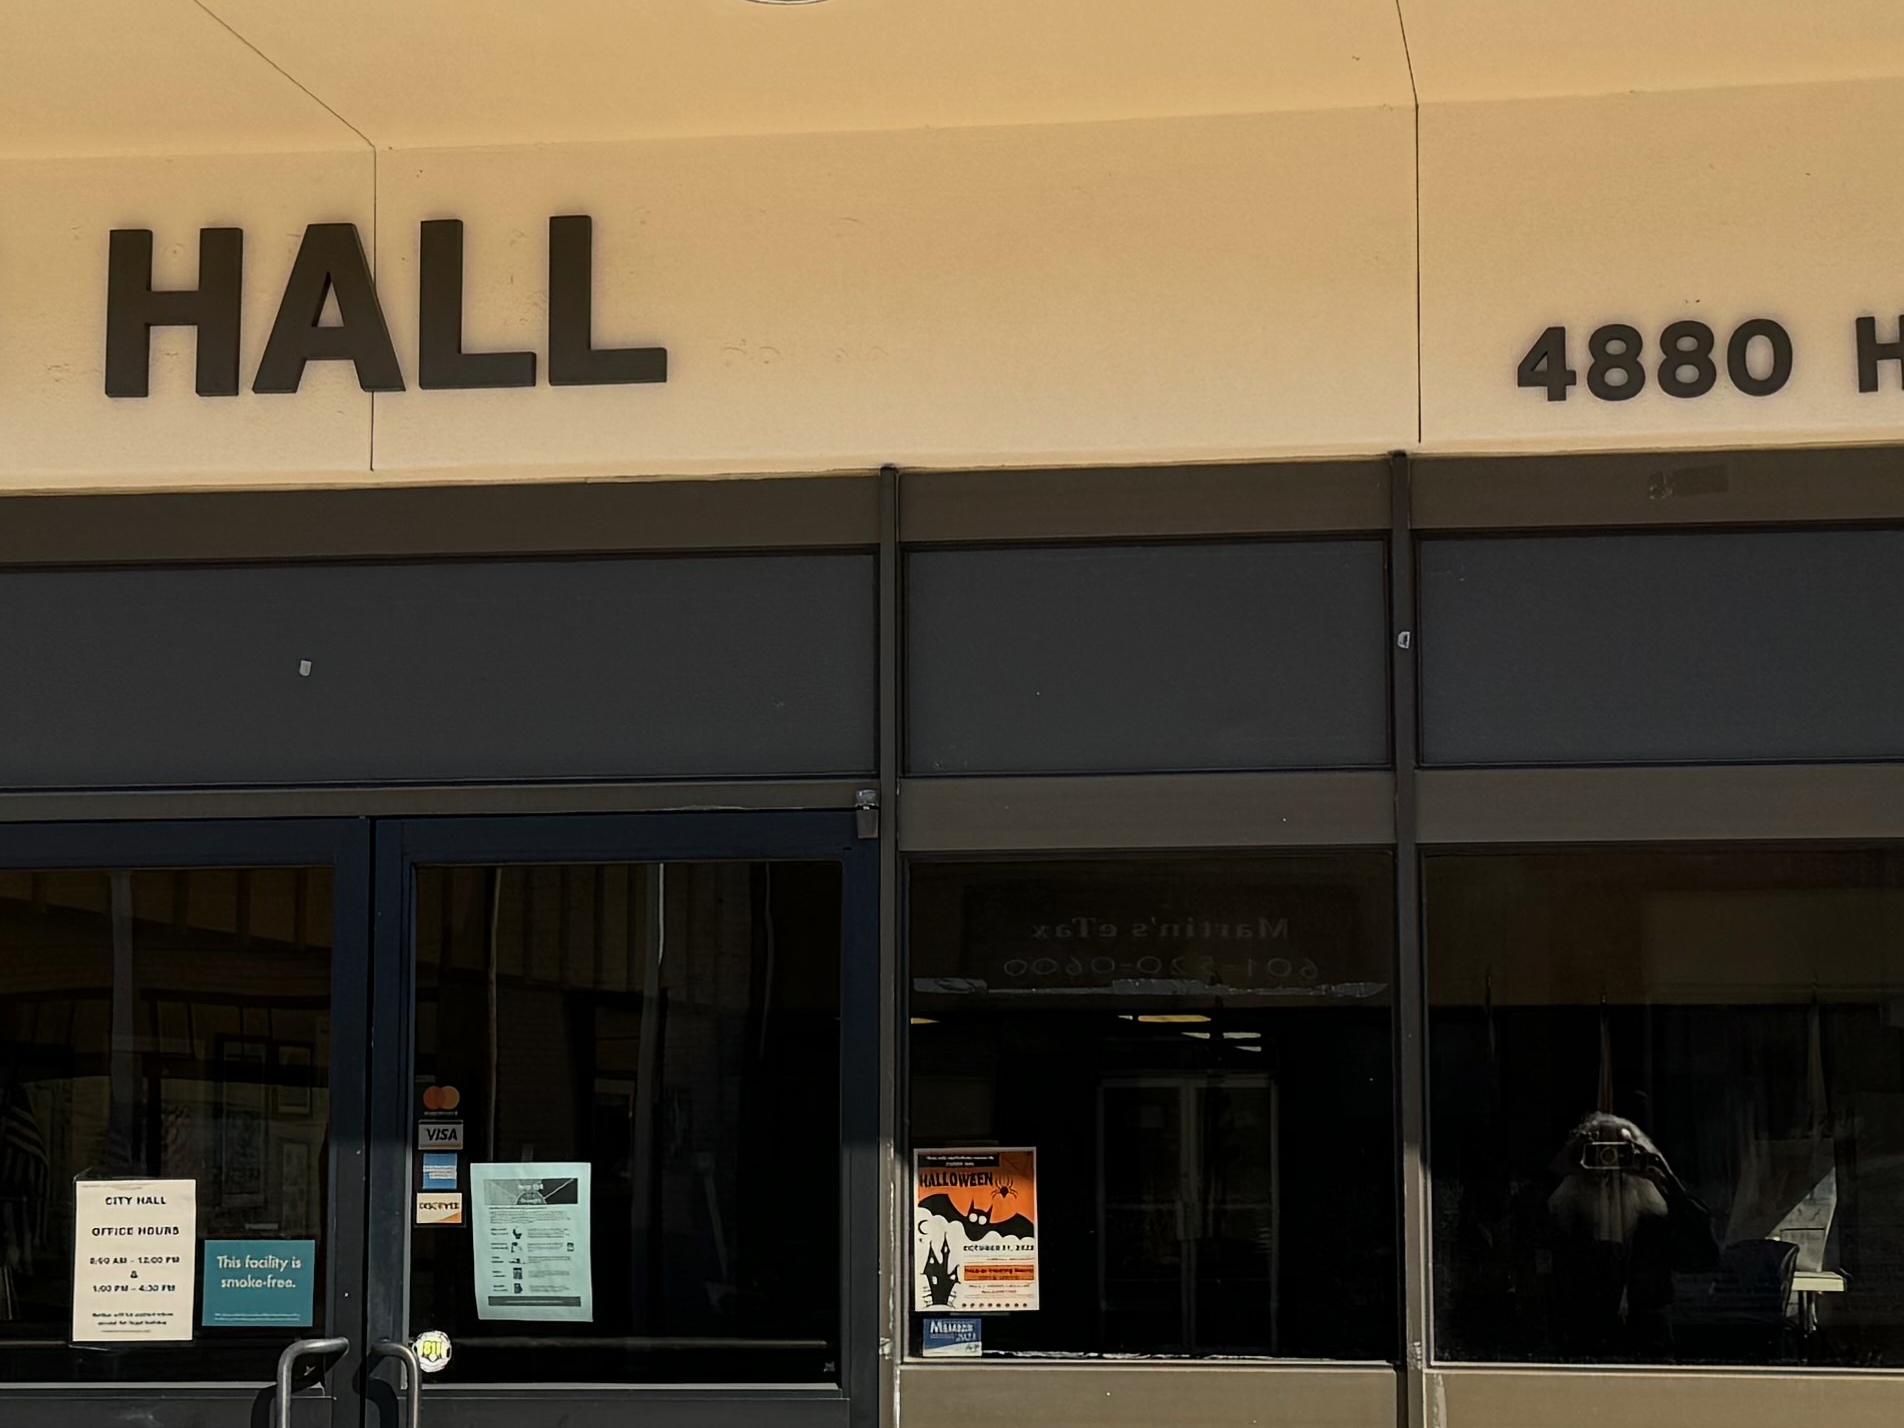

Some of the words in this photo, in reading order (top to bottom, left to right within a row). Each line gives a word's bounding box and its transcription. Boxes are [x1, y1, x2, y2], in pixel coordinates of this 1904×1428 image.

[104, 214, 668, 398] HALL
[1516, 318, 1794, 402] 4880
[426, 1128, 458, 1141] VISA
[920, 1172, 994, 1188] HALLOWEEN
[105, 1196, 133, 1206] CITY
[137, 1196, 167, 1205] HALL
[91, 1227, 134, 1237] OFFICE
[138, 1226, 180, 1236] HOURS
[216, 1255, 241, 1269] This
[245, 1255, 289, 1272] facility
[291, 1256, 302, 1269] is
[221, 1274, 296, 1288] smoke-free.
